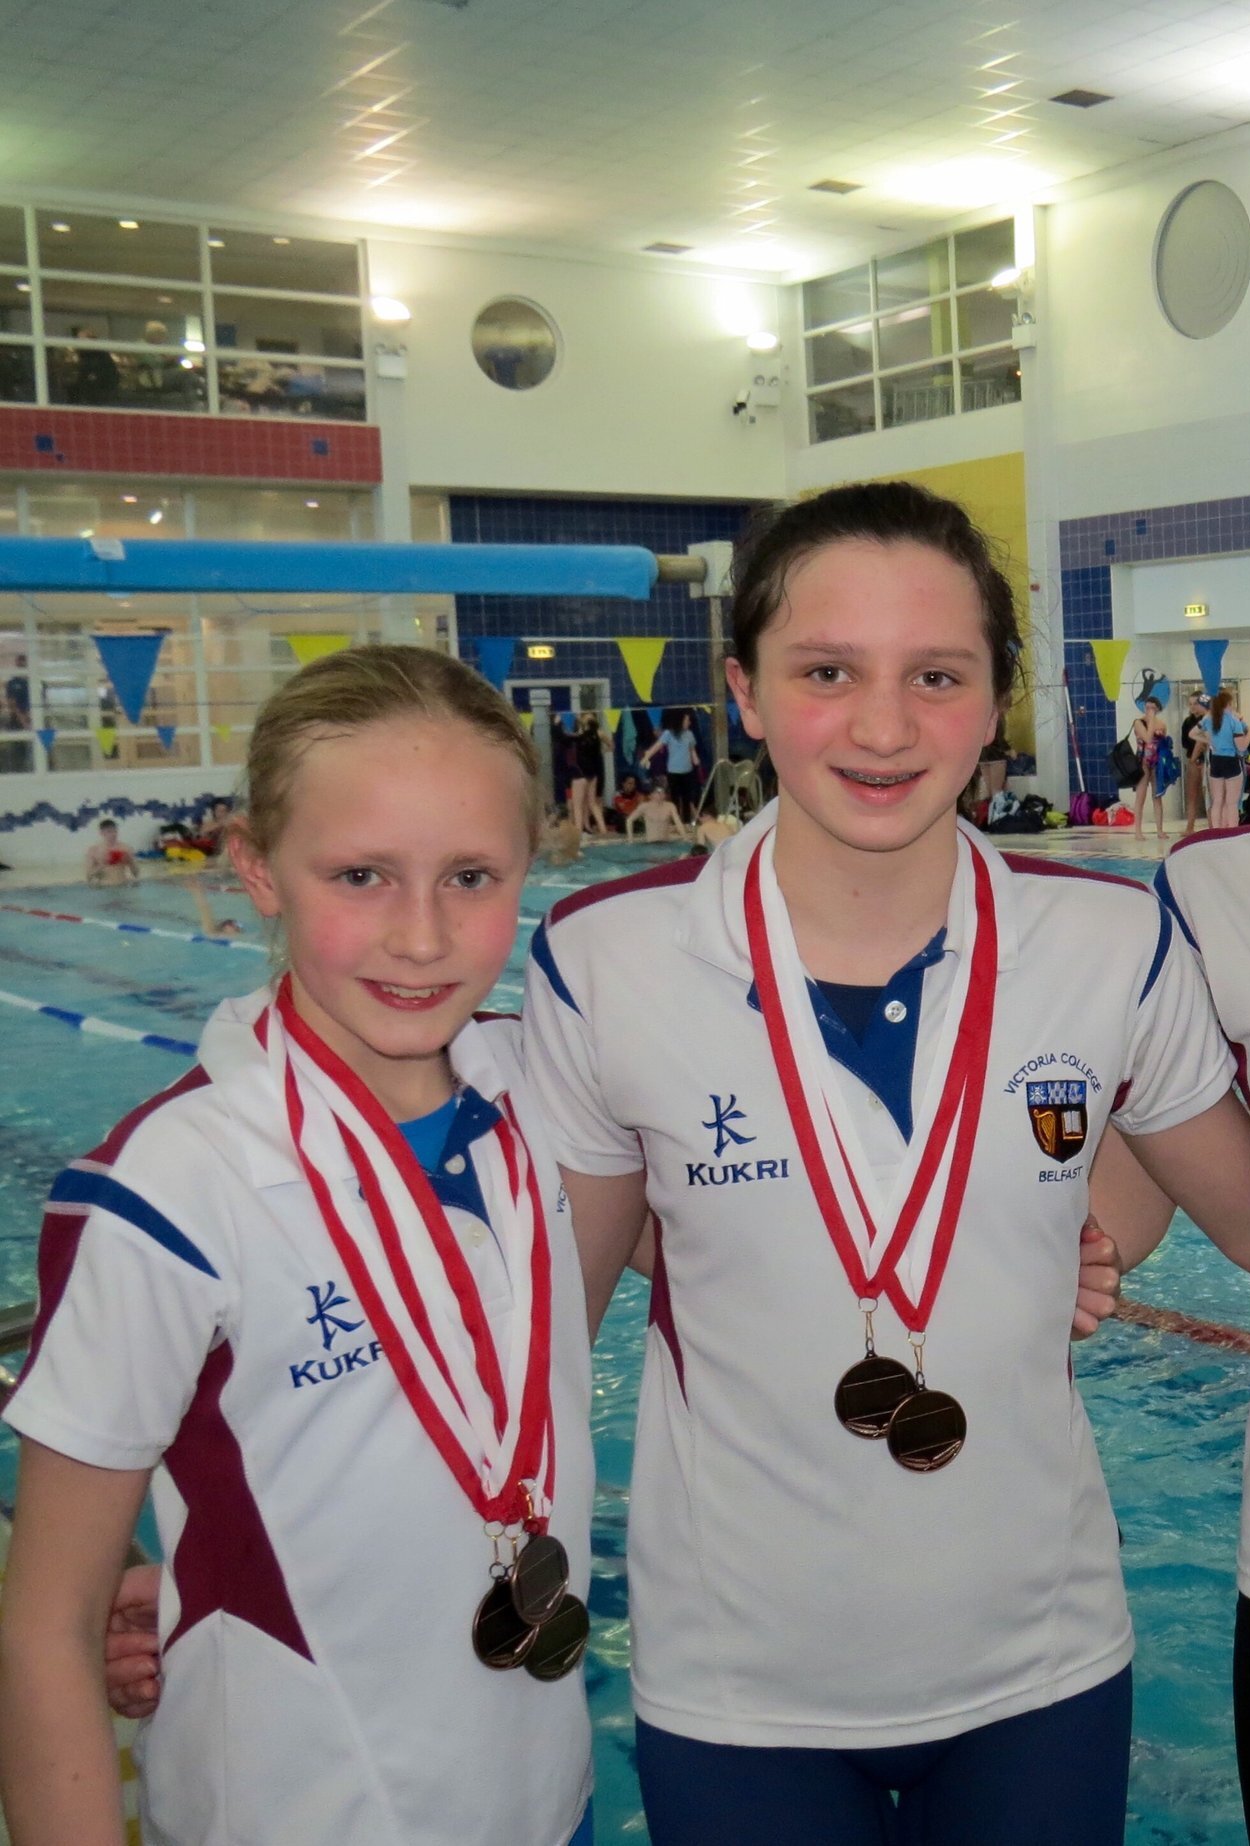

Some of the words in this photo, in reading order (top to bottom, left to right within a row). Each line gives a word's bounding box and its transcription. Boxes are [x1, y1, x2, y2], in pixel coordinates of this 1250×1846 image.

[1003, 1052, 1058, 1095] VICTORIA
[1060, 1052, 1103, 1094] COLLEGE
[685, 1158, 790, 1186] KUKRI
[1038, 1165, 1084, 1183] BELFAST
